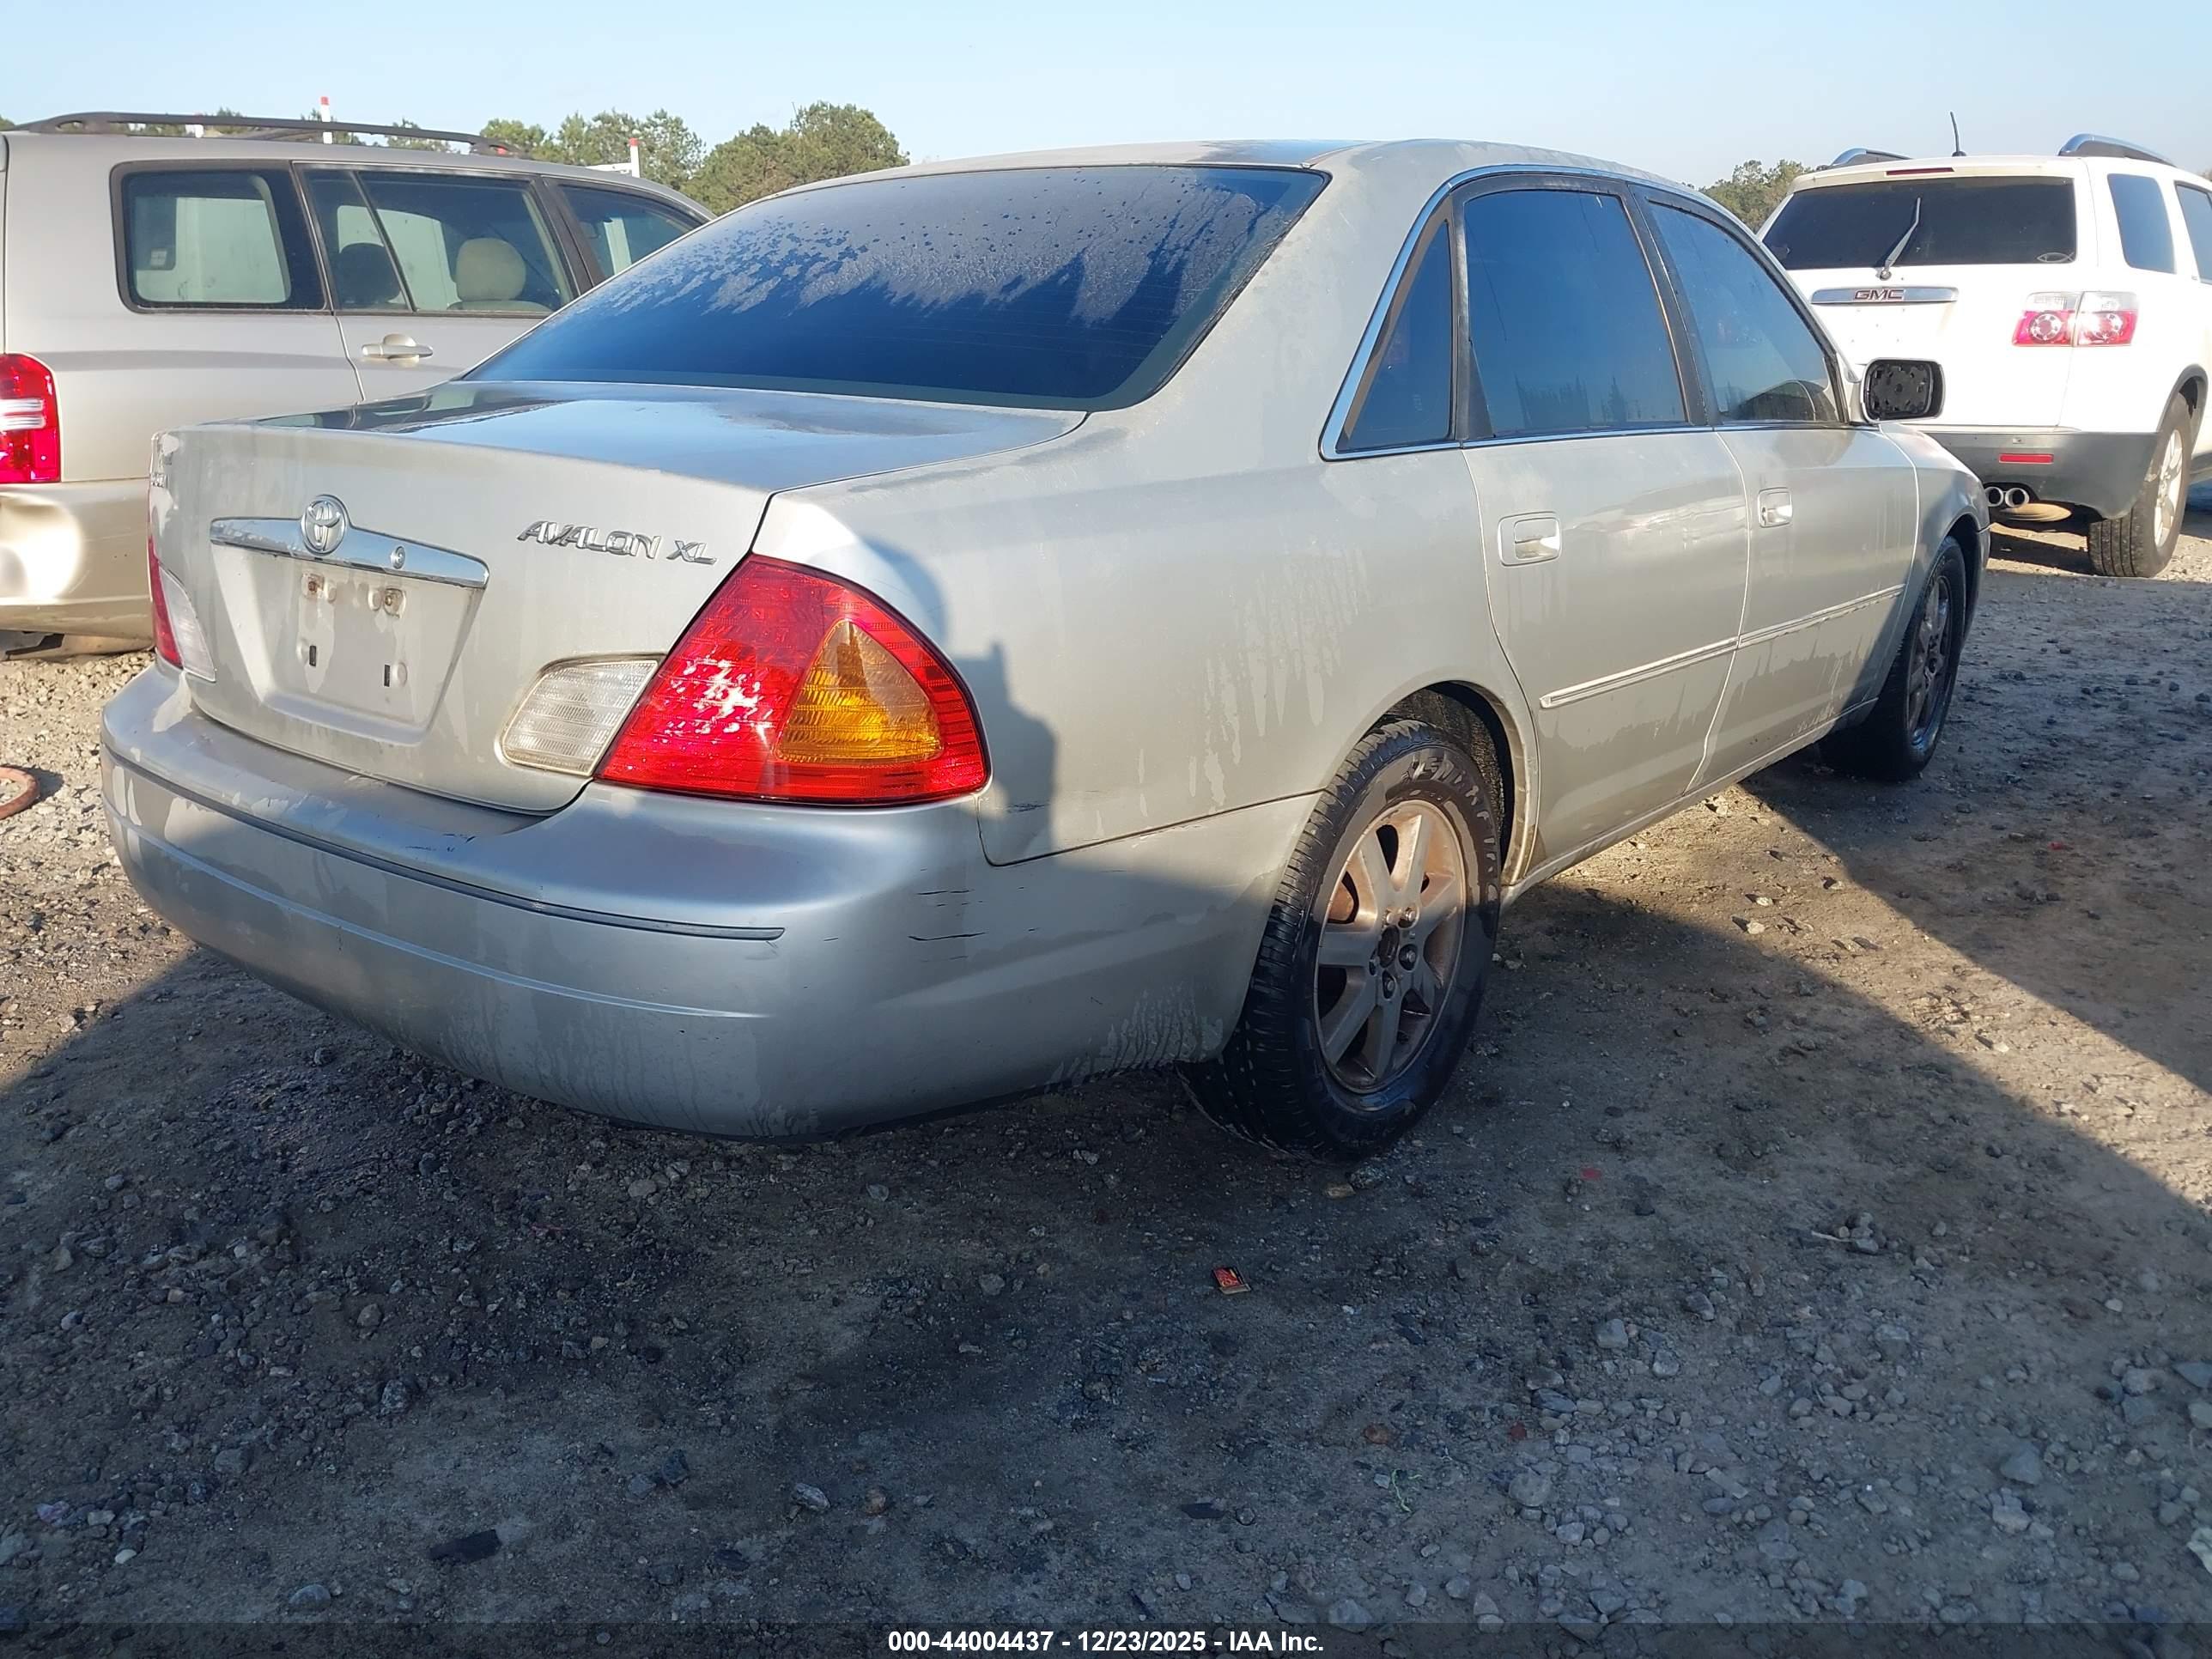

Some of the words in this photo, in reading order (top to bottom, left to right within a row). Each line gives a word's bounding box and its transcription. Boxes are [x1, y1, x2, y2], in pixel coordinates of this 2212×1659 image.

[1854, 289, 1905, 301] GMC
[516, 520, 661, 559] AVALON
[665, 539, 717, 565] XL
